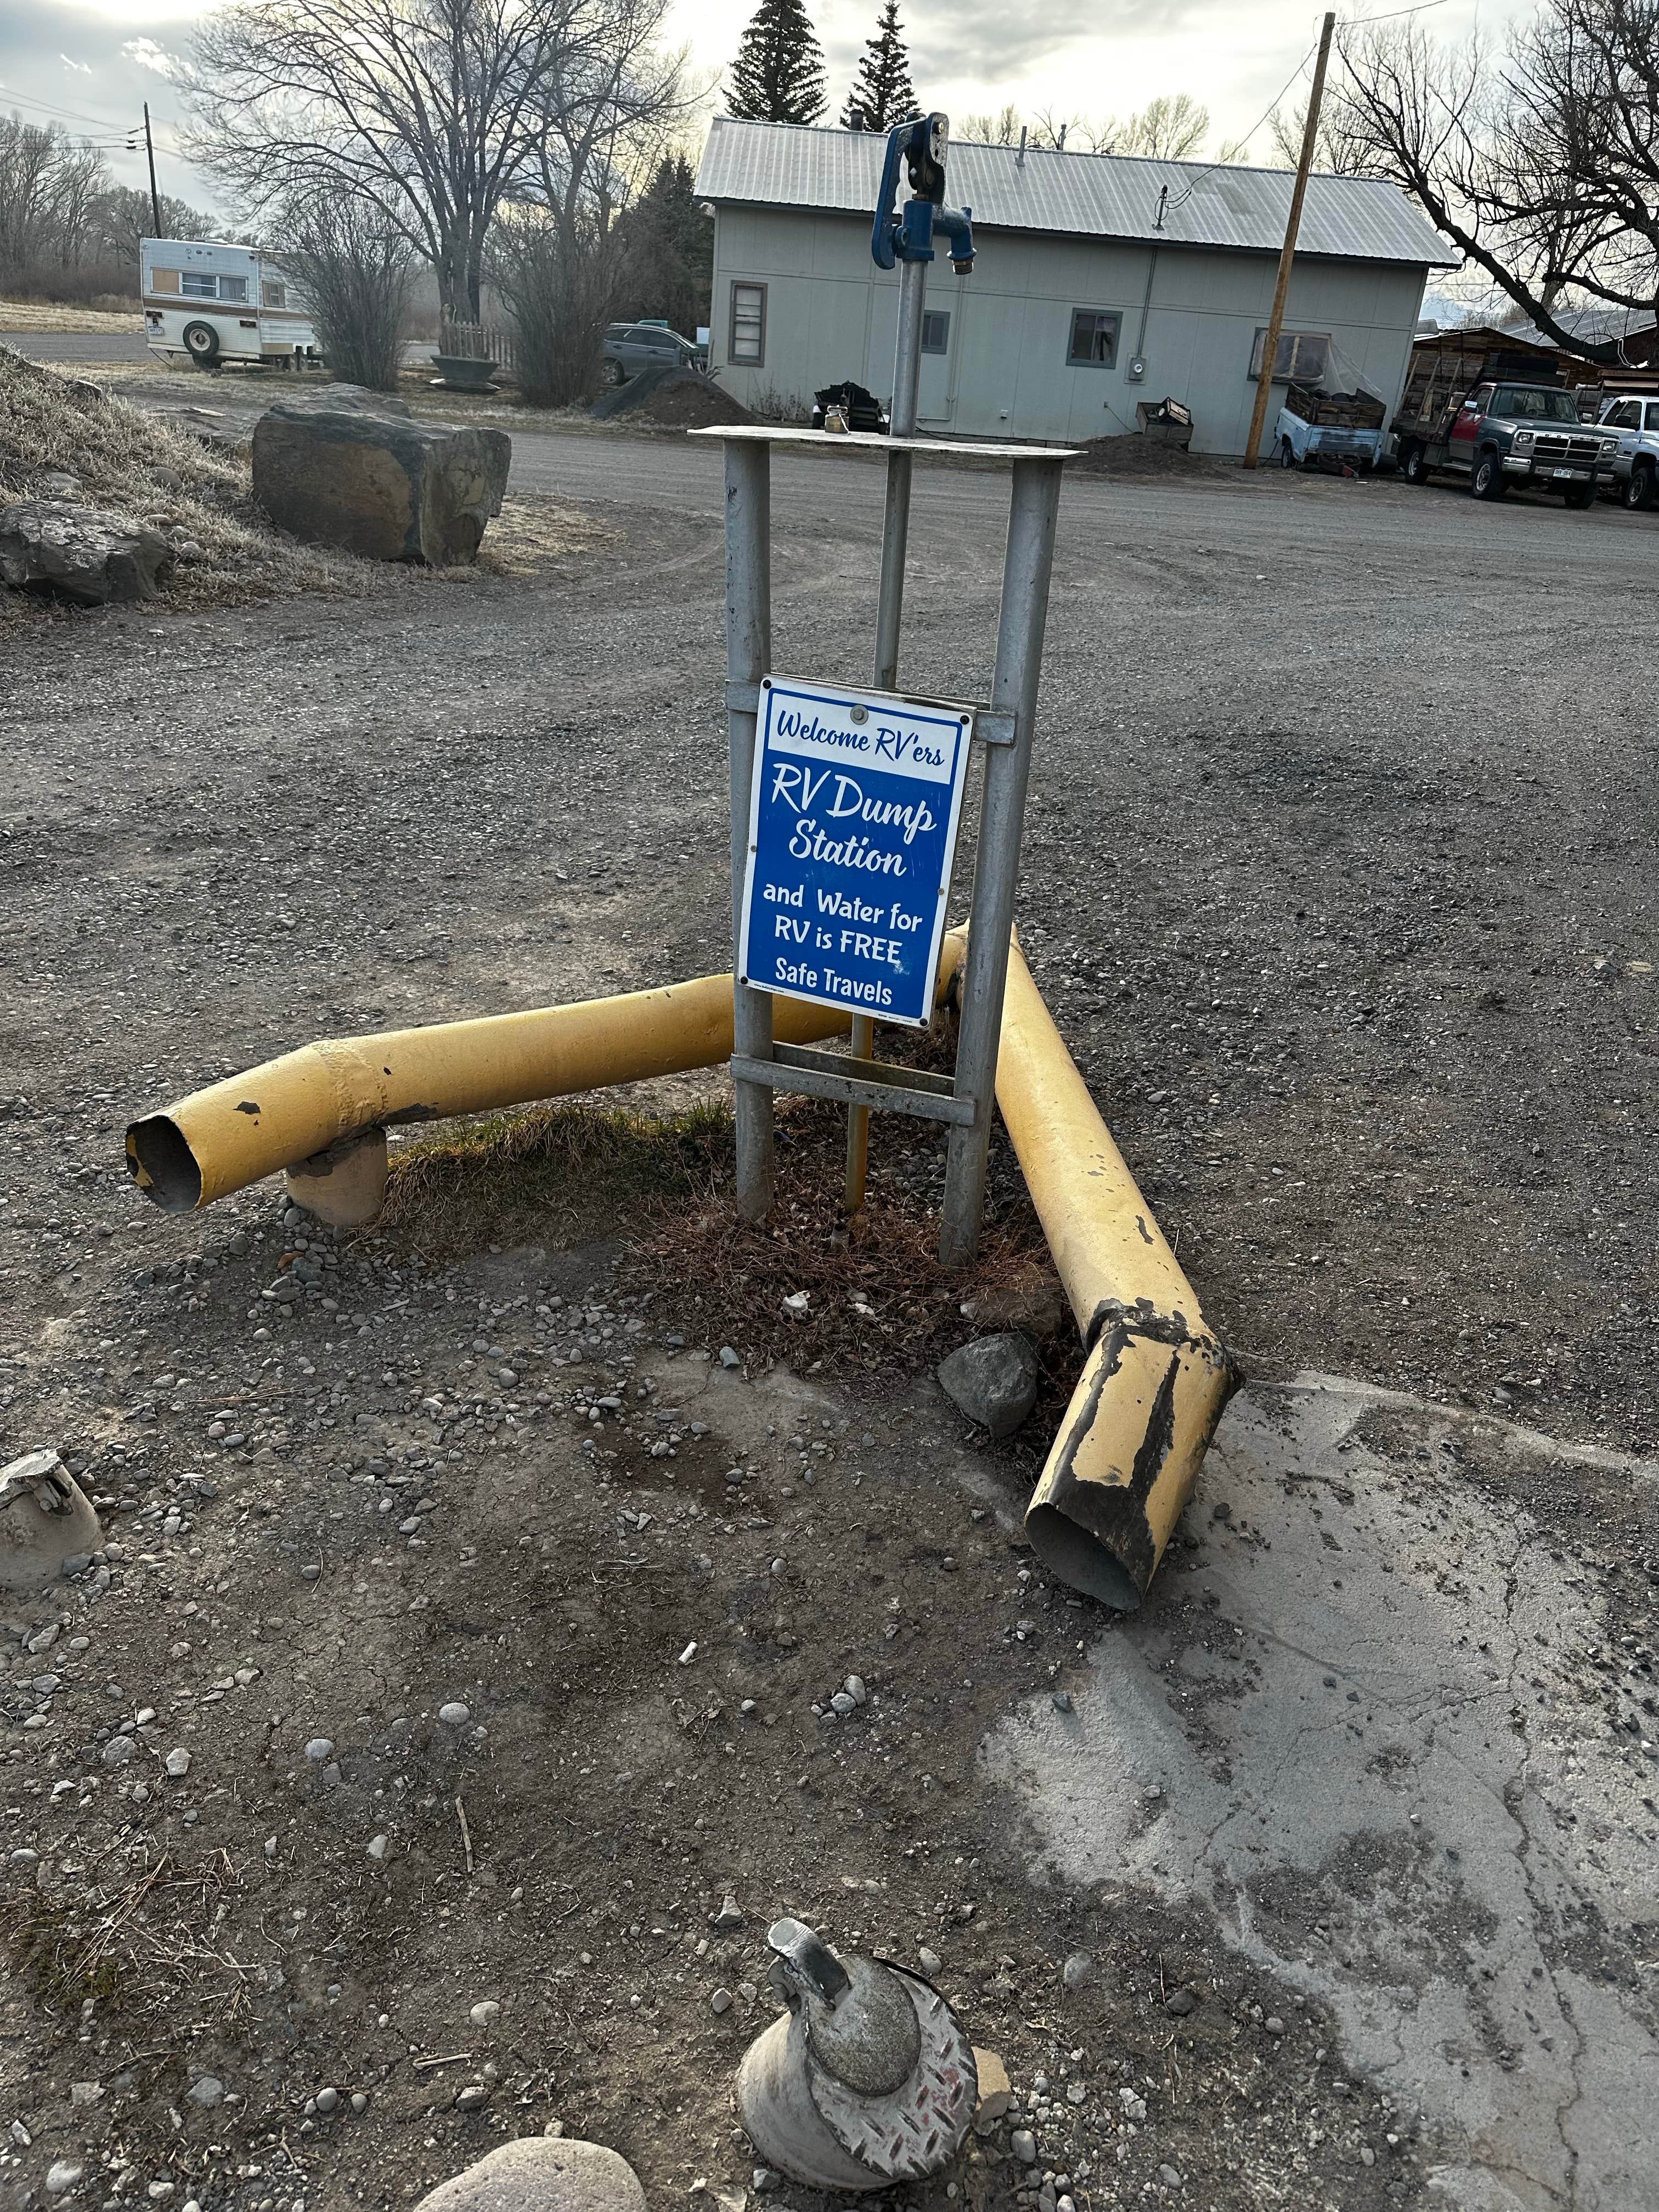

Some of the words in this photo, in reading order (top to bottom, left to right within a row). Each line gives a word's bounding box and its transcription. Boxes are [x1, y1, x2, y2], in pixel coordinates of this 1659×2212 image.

[777, 710, 870, 751] Welcome
[874, 727, 944, 766] RV'ers
[771, 763, 832, 814] RV
[826, 775, 938, 845] Dump
[788, 819, 907, 877] Station
[763, 883, 804, 908] and
[817, 889, 884, 924] Water
[889, 903, 923, 933] for
[775, 915, 811, 944] RV
[816, 927, 832, 950] is
[840, 930, 903, 969] FREE
[775, 957, 817, 989] Safe
[823, 968, 892, 1006] Travels
